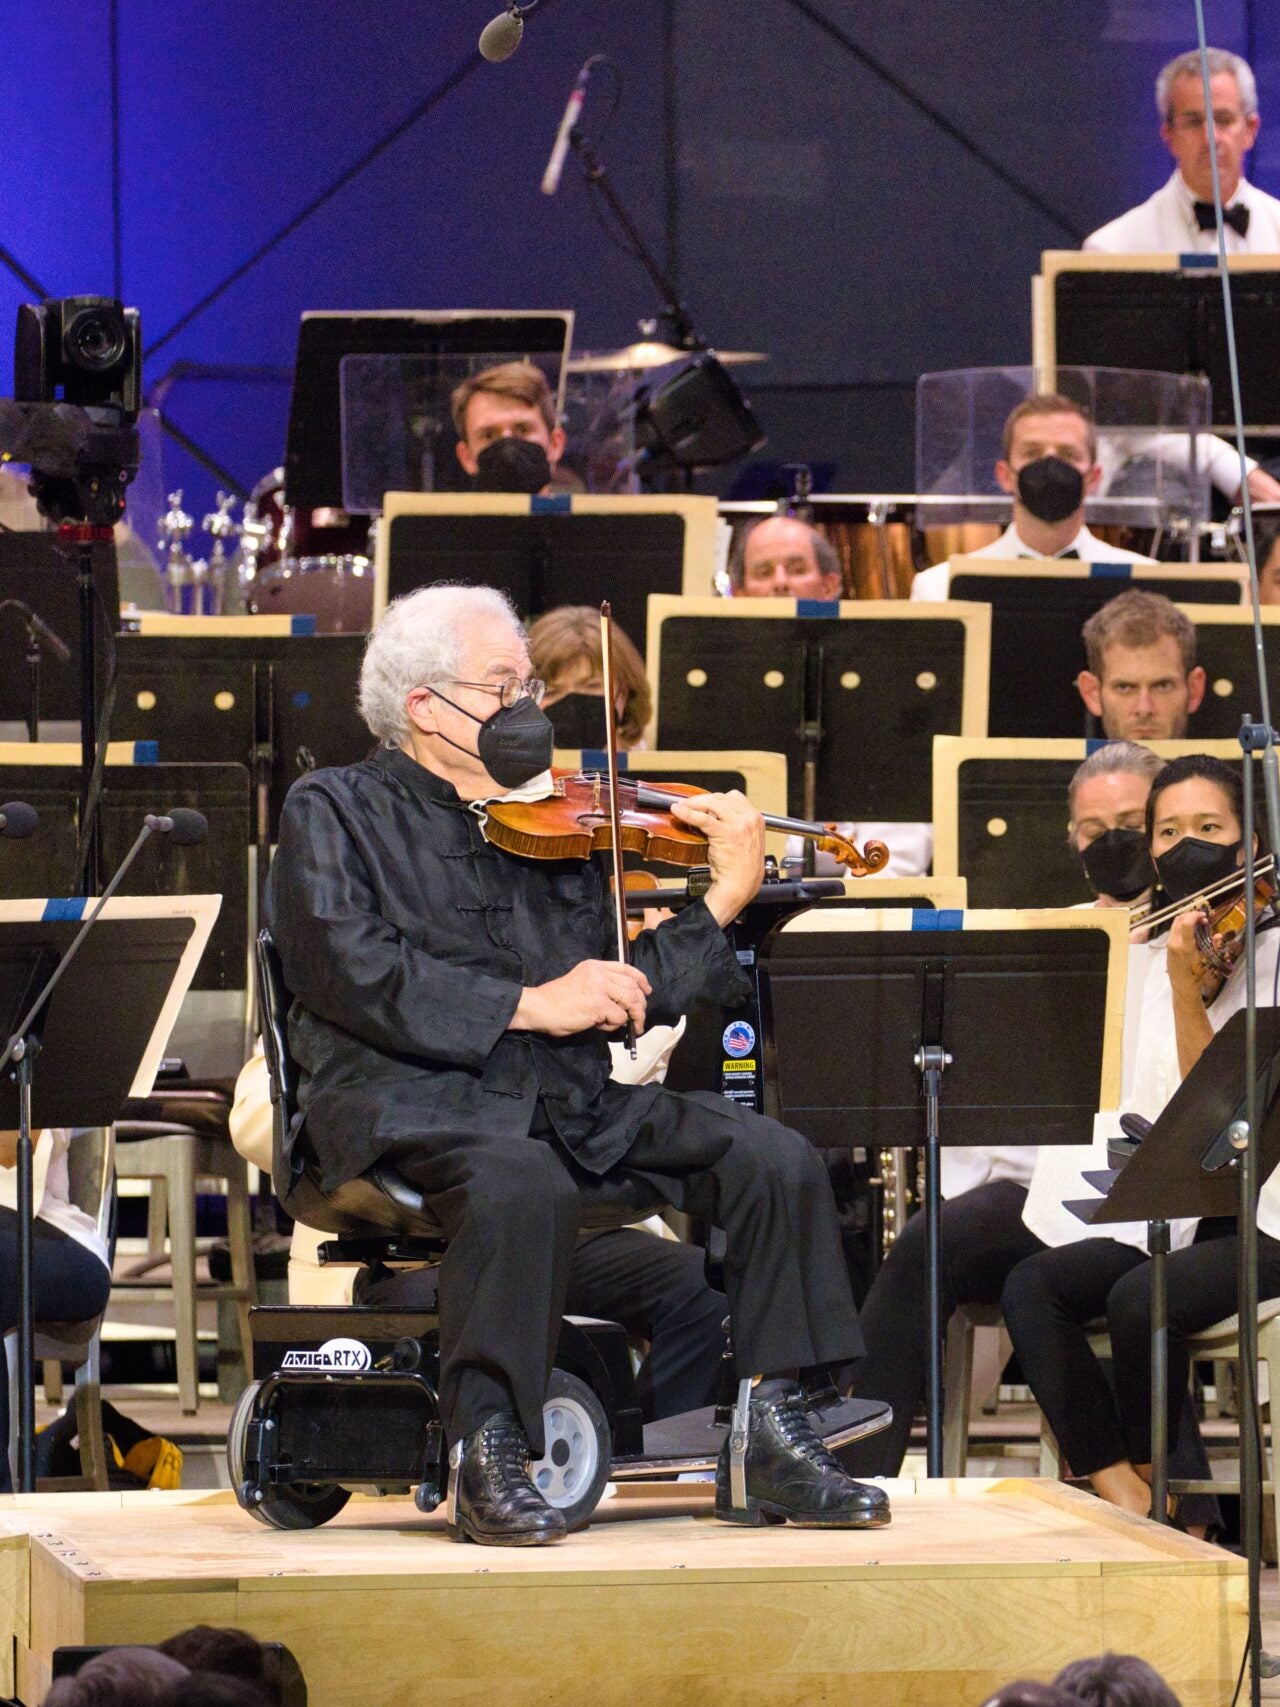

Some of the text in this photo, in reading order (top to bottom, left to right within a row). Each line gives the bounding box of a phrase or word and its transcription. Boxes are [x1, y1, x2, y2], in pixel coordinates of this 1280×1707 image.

[725, 1061, 754, 1070] WARNING
[284, 1350, 361, 1366] AMIGA RTX
